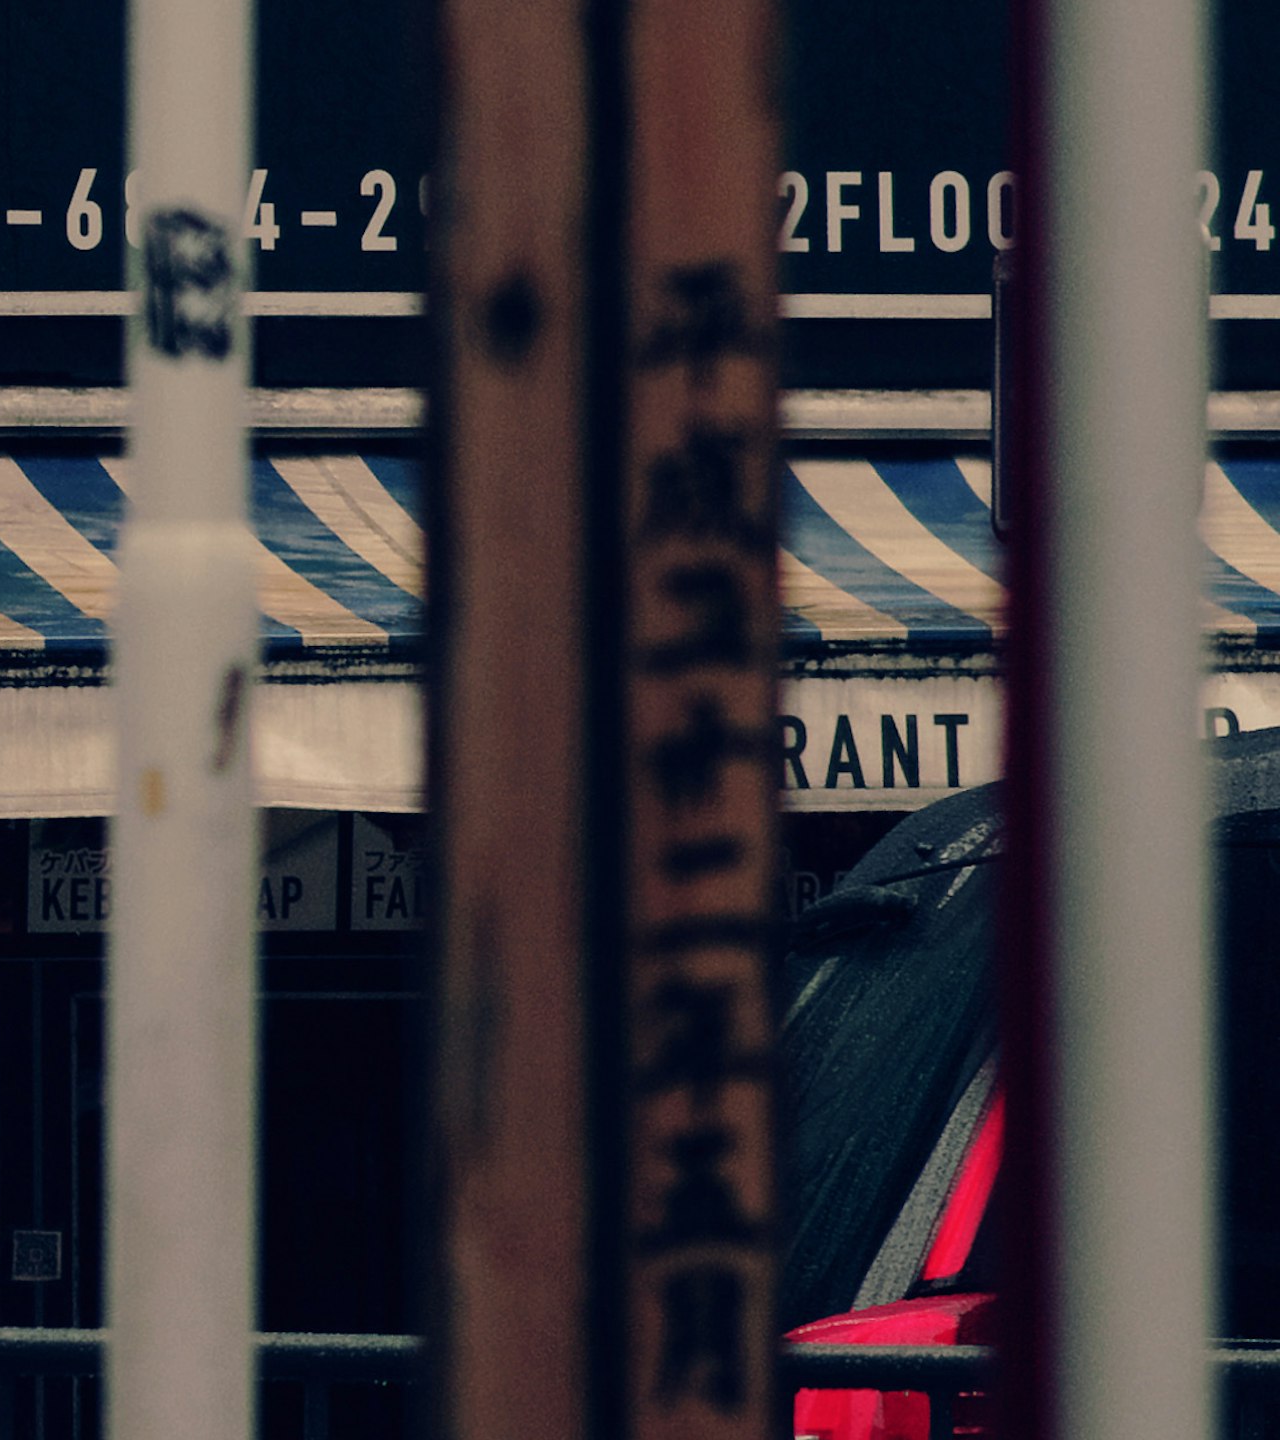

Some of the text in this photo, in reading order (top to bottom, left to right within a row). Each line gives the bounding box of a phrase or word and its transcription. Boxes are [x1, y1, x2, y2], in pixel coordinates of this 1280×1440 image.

[777, 168, 1022, 254] 2FLOO
[770, 712, 970, 789] RANT
[40, 850, 110, 875] ケバブ
[259, 876, 303, 919] AP
[366, 875, 428, 919] FAL
